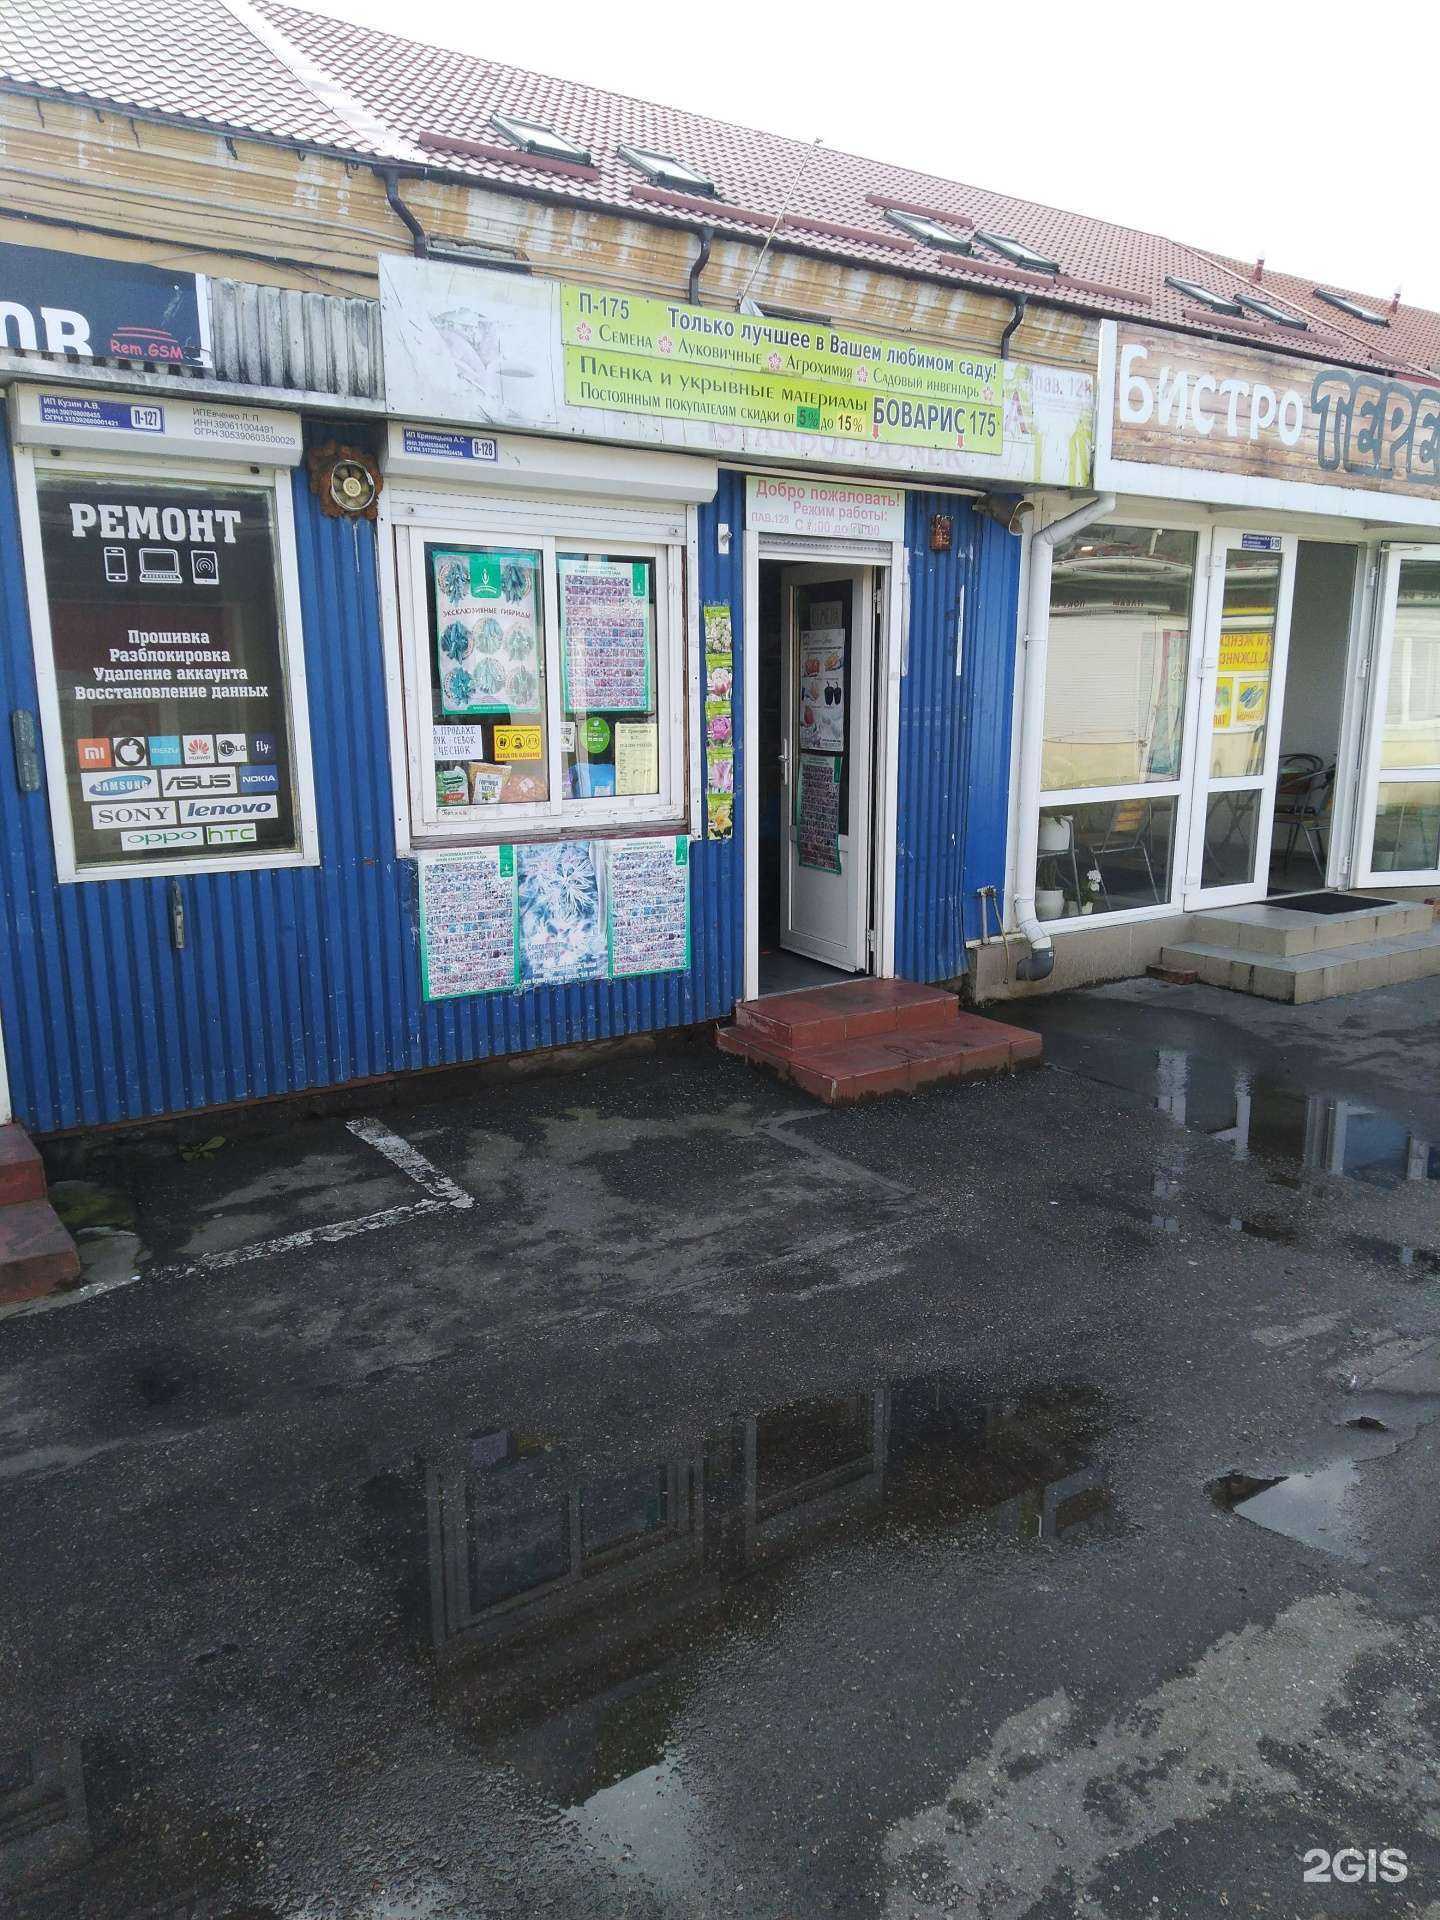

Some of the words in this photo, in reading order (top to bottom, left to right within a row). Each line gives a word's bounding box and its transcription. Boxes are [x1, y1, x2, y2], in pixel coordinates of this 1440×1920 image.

[579, 292, 630, 320] П-175
[110, 339, 143, 356] Rem
[147, 344, 184, 360] GSM
[667, 307, 735, 337] Только
[741, 323, 811, 349] лучшее
[815, 338, 825, 351] в
[829, 333, 882, 362] Вашем
[886, 348, 954, 374] любимом
[958, 361, 997, 384] саду!
[43, 397, 56, 406] ИП
[58, 398, 82, 410] Кузин
[134, 409, 158, 427] П-127
[193, 418, 213, 428] ИНН
[838, 414, 863, 434] 15%
[872, 396, 966, 434] БОВАРИС
[969, 410, 996, 437] 175
[193, 427, 218, 438] ОГРН
[474, 442, 493, 457] П-128
[755, 479, 806, 501] Добро
[810, 488, 901, 508] пожаловать!
[793, 500, 835, 518] Режим
[838, 505, 888, 522] работы:
[69, 502, 241, 544] РЕМОНТ
[127, 629, 210, 646] Прошивка
[109, 648, 231, 664] Разблокировка
[93, 667, 172, 682] Удаление
[176, 667, 249, 683] аккаунта
[74, 686, 208, 700] Восстановление
[211, 685, 269, 699] данных
[95, 778, 149, 792] SAMSUNG
[165, 773, 231, 791] ASUS
[242, 774, 276, 783] NOKIA
[98, 806, 170, 824] SONY
[187, 802, 272, 817] lenovo
